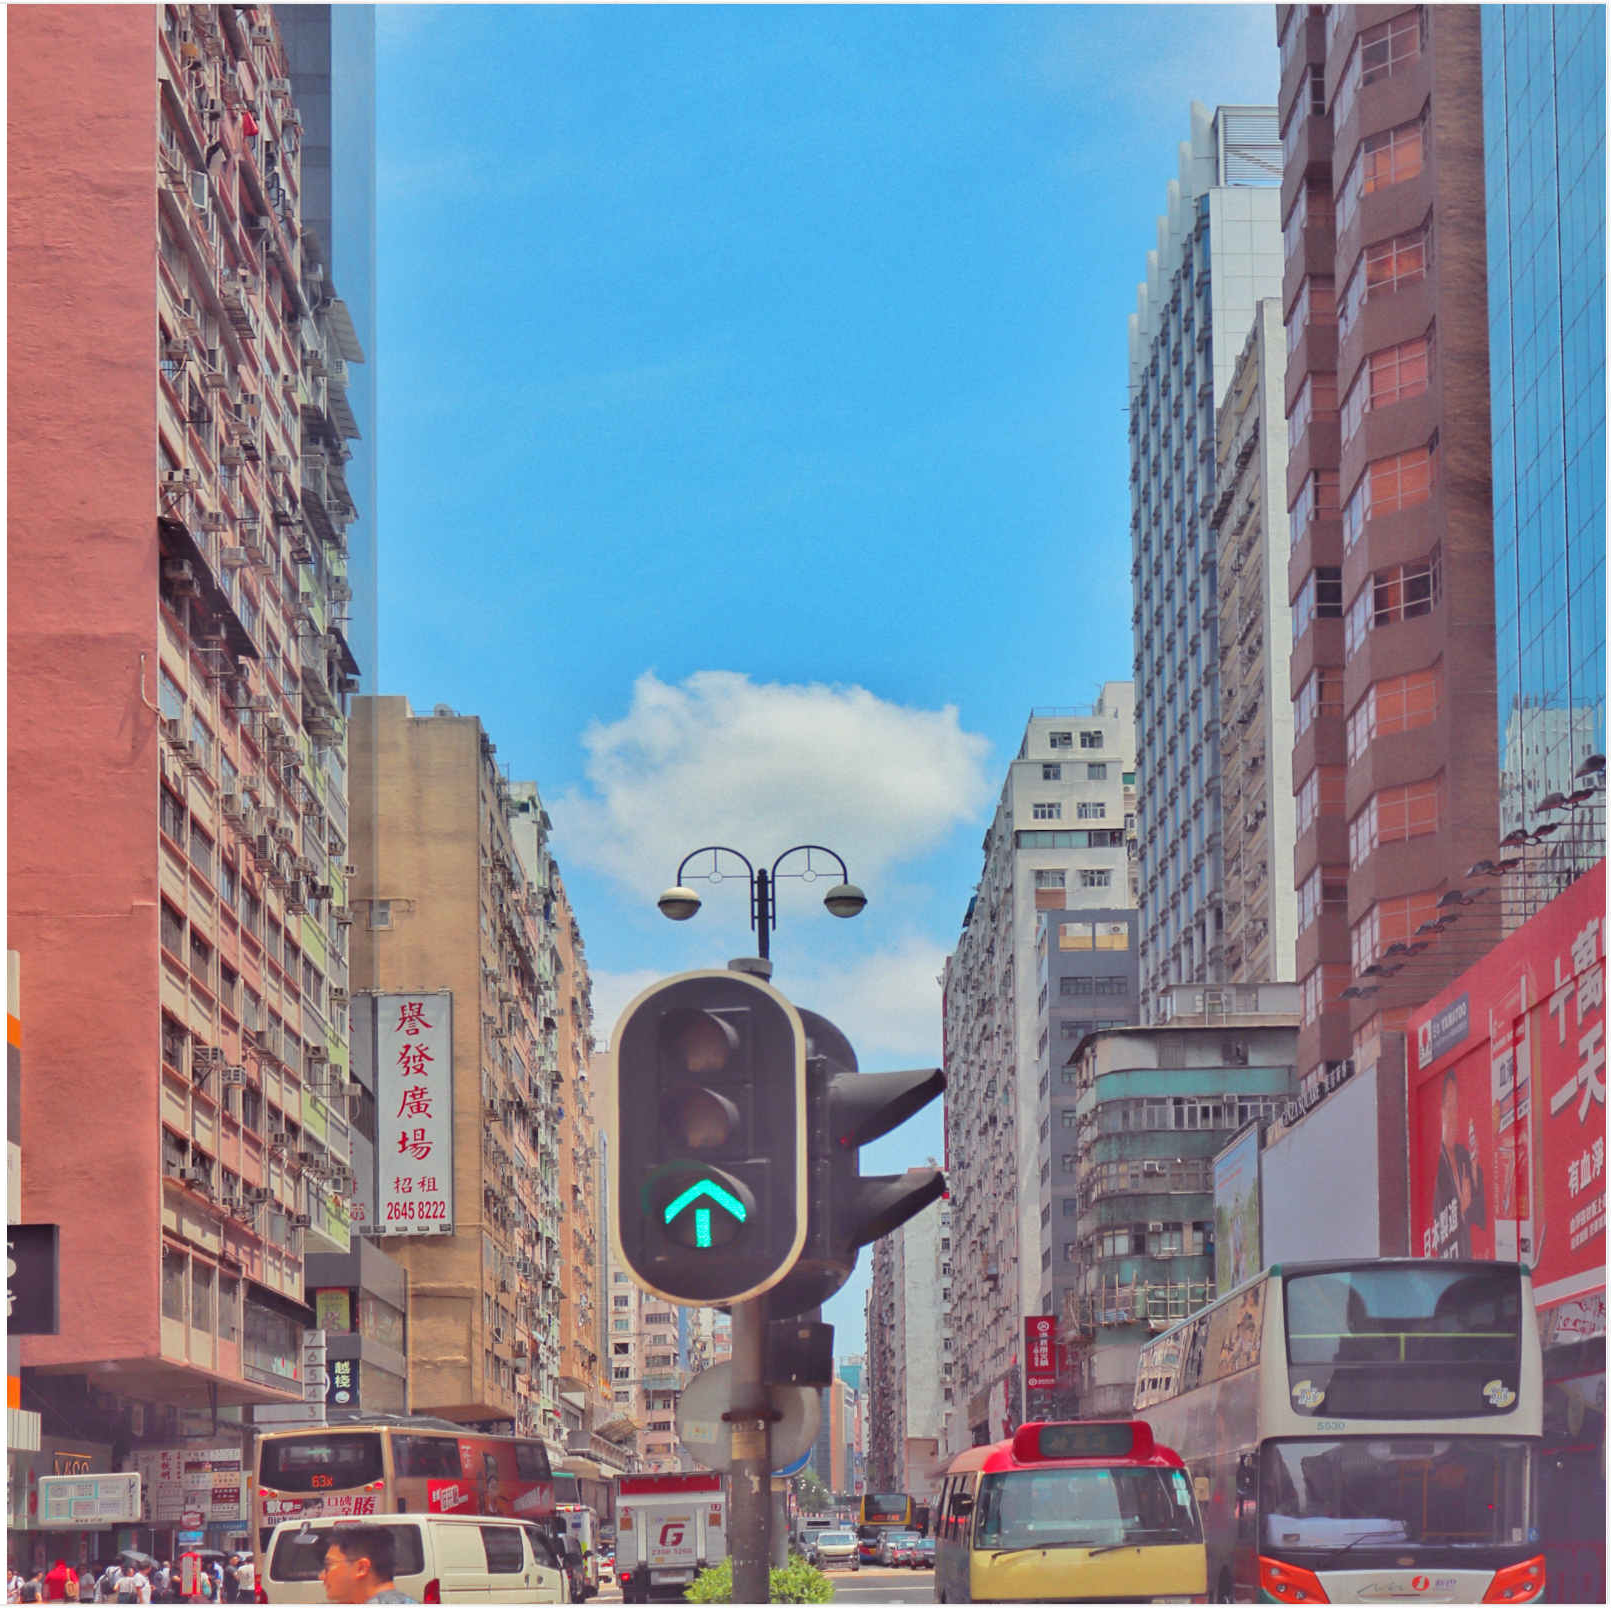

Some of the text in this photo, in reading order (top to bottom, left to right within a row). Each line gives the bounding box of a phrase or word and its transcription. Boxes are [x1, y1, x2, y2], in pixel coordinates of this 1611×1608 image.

[394, 1001, 435, 1161] 譽發廣場
[393, 1176, 438, 1194] 招租
[387, 1201, 446, 1220] 2645 8222
